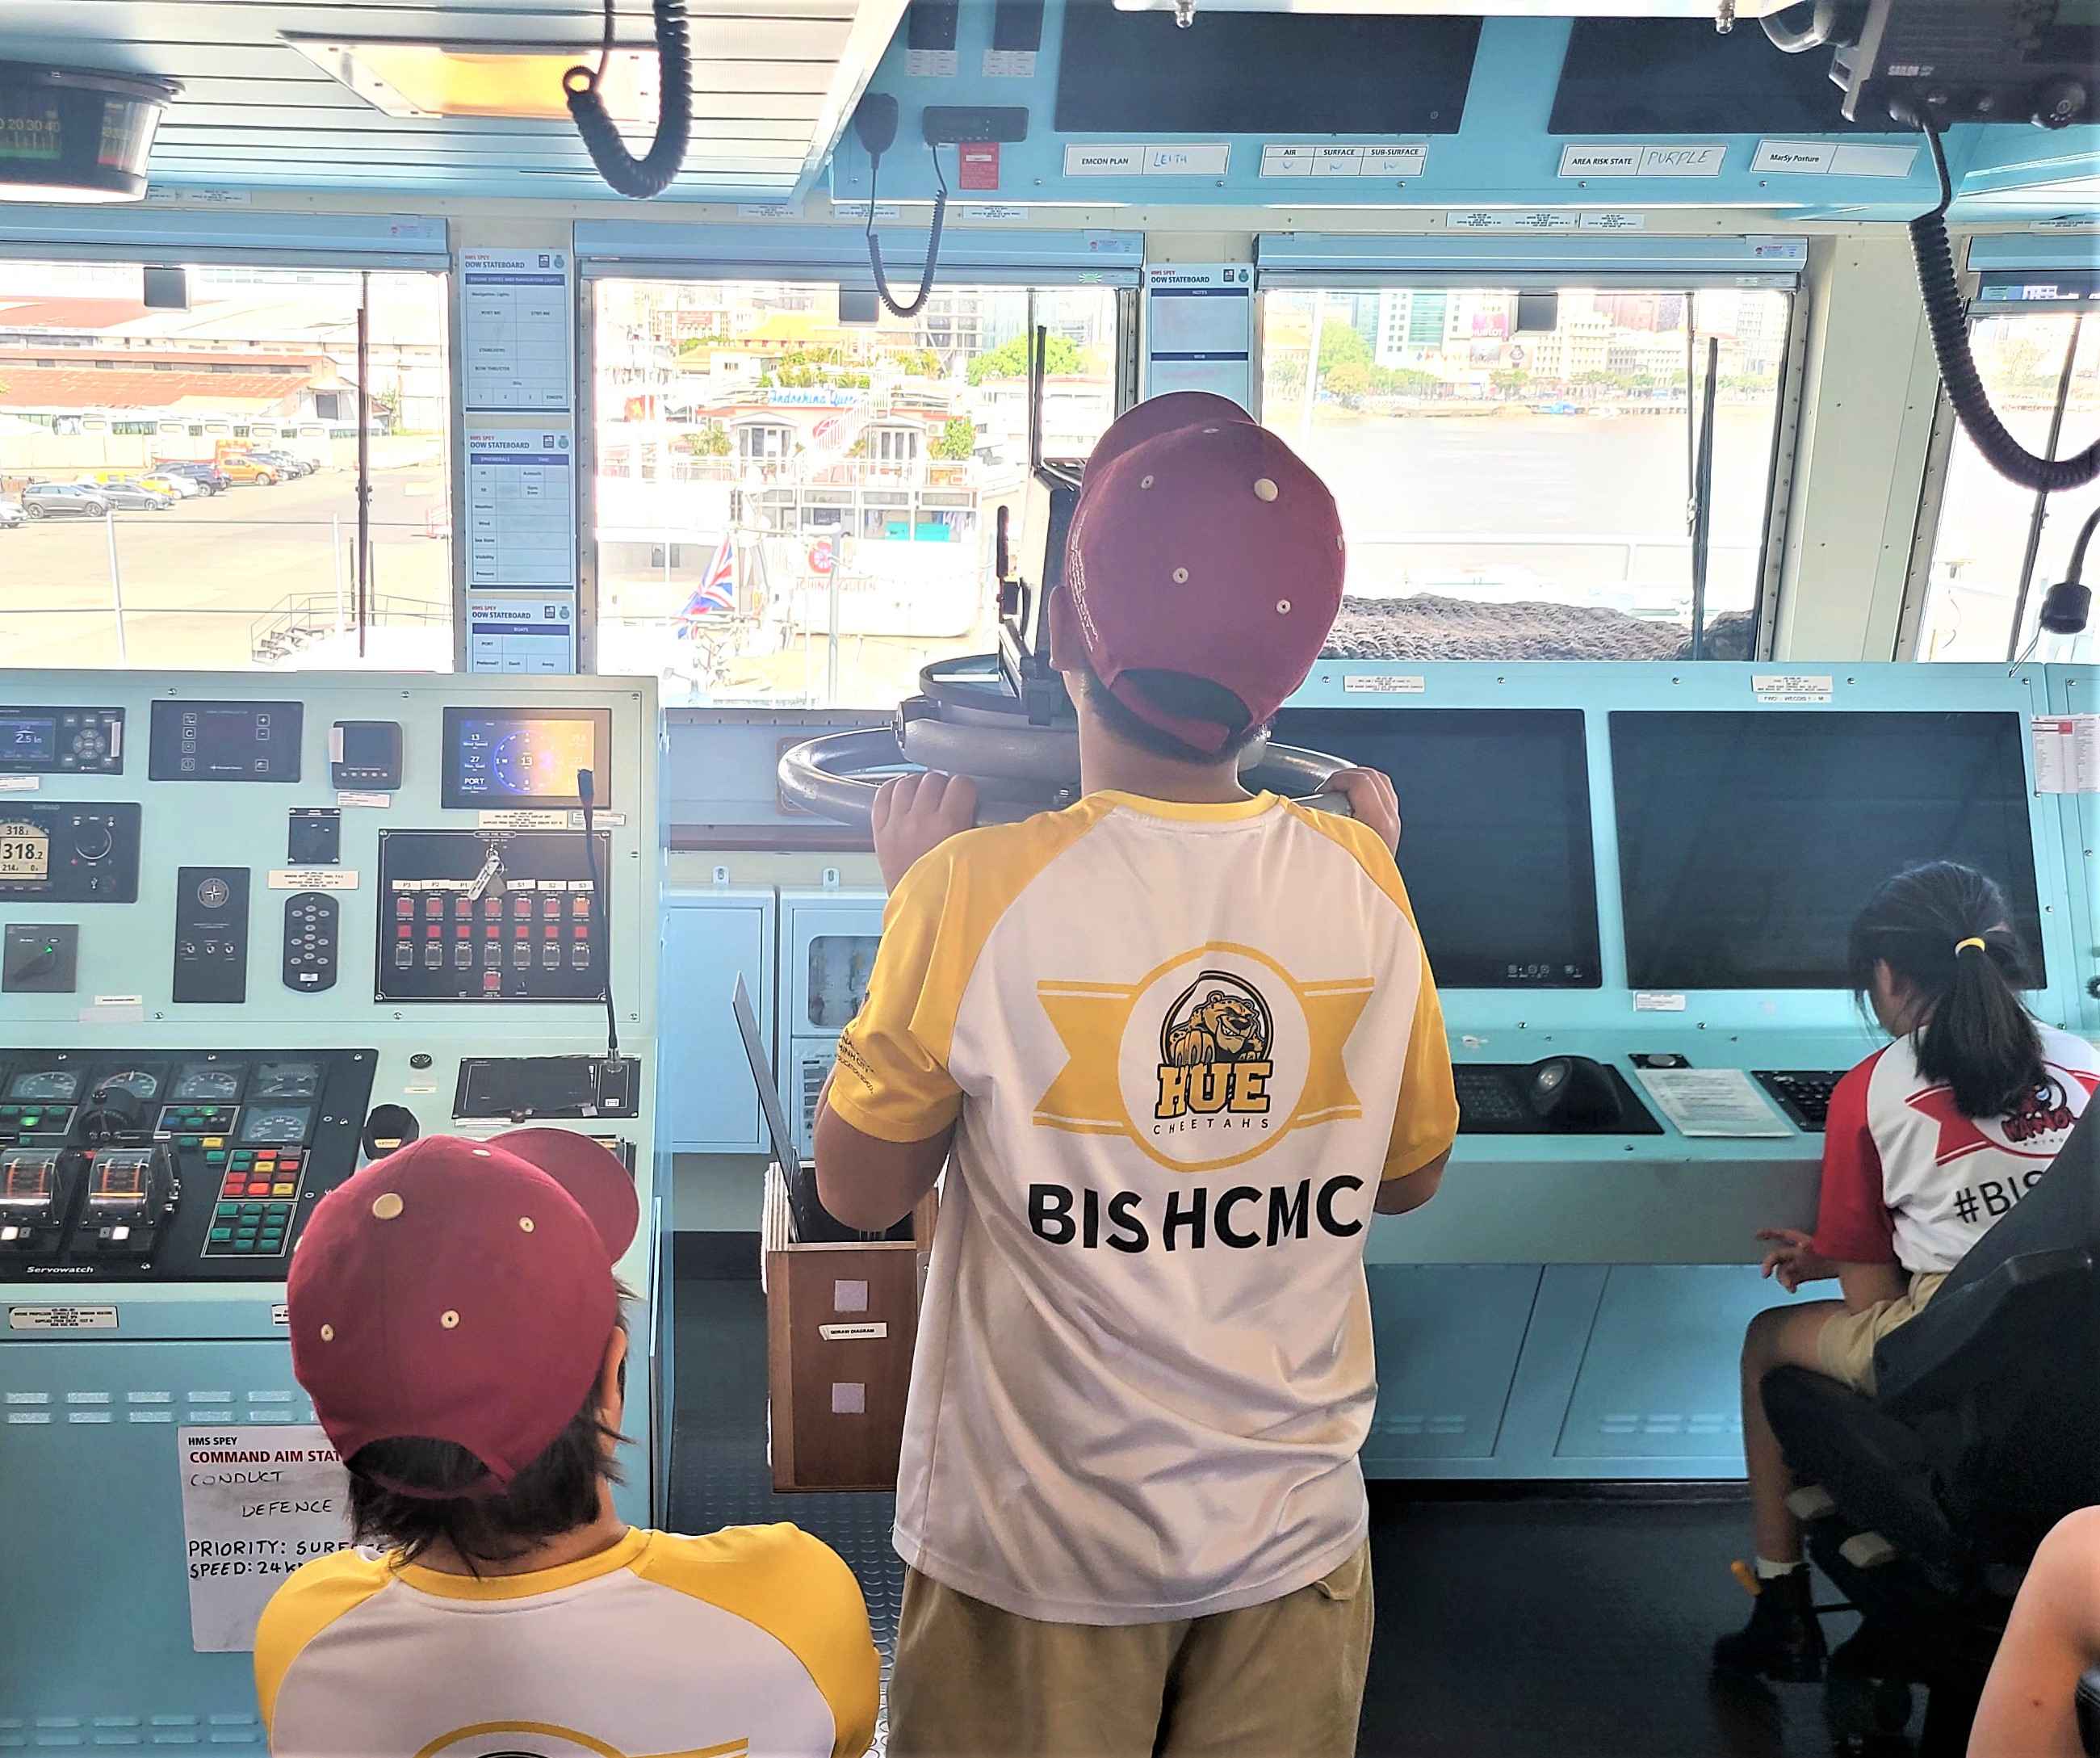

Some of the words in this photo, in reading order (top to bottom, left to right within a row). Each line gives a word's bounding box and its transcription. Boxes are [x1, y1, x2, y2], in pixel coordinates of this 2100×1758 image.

[1082, 157, 1109, 166] EMCON
[1110, 157, 1129, 166] PLAN
[1647, 149, 1712, 166] PURPLE
[484, 261, 525, 269] STATEBOARD
[2, 843, 43, 860] 318.2
[1155, 1059, 1274, 1119] HUE
[1153, 1118, 1269, 1135] CHEETAHS
[1029, 1183, 1149, 1254] BIS
[1163, 1174, 1364, 1252] HCMC
[188, 1437, 211, 1445] HMS
[212, 1437, 237, 1445] SPEY
[190, 1451, 270, 1463] COMMAND
[274, 1450, 303, 1462] AIM
[241, 1499, 333, 1517] DEFENCE
[188, 1540, 286, 1557] PRIORITY:
[190, 1562, 253, 1579] SPEED:
